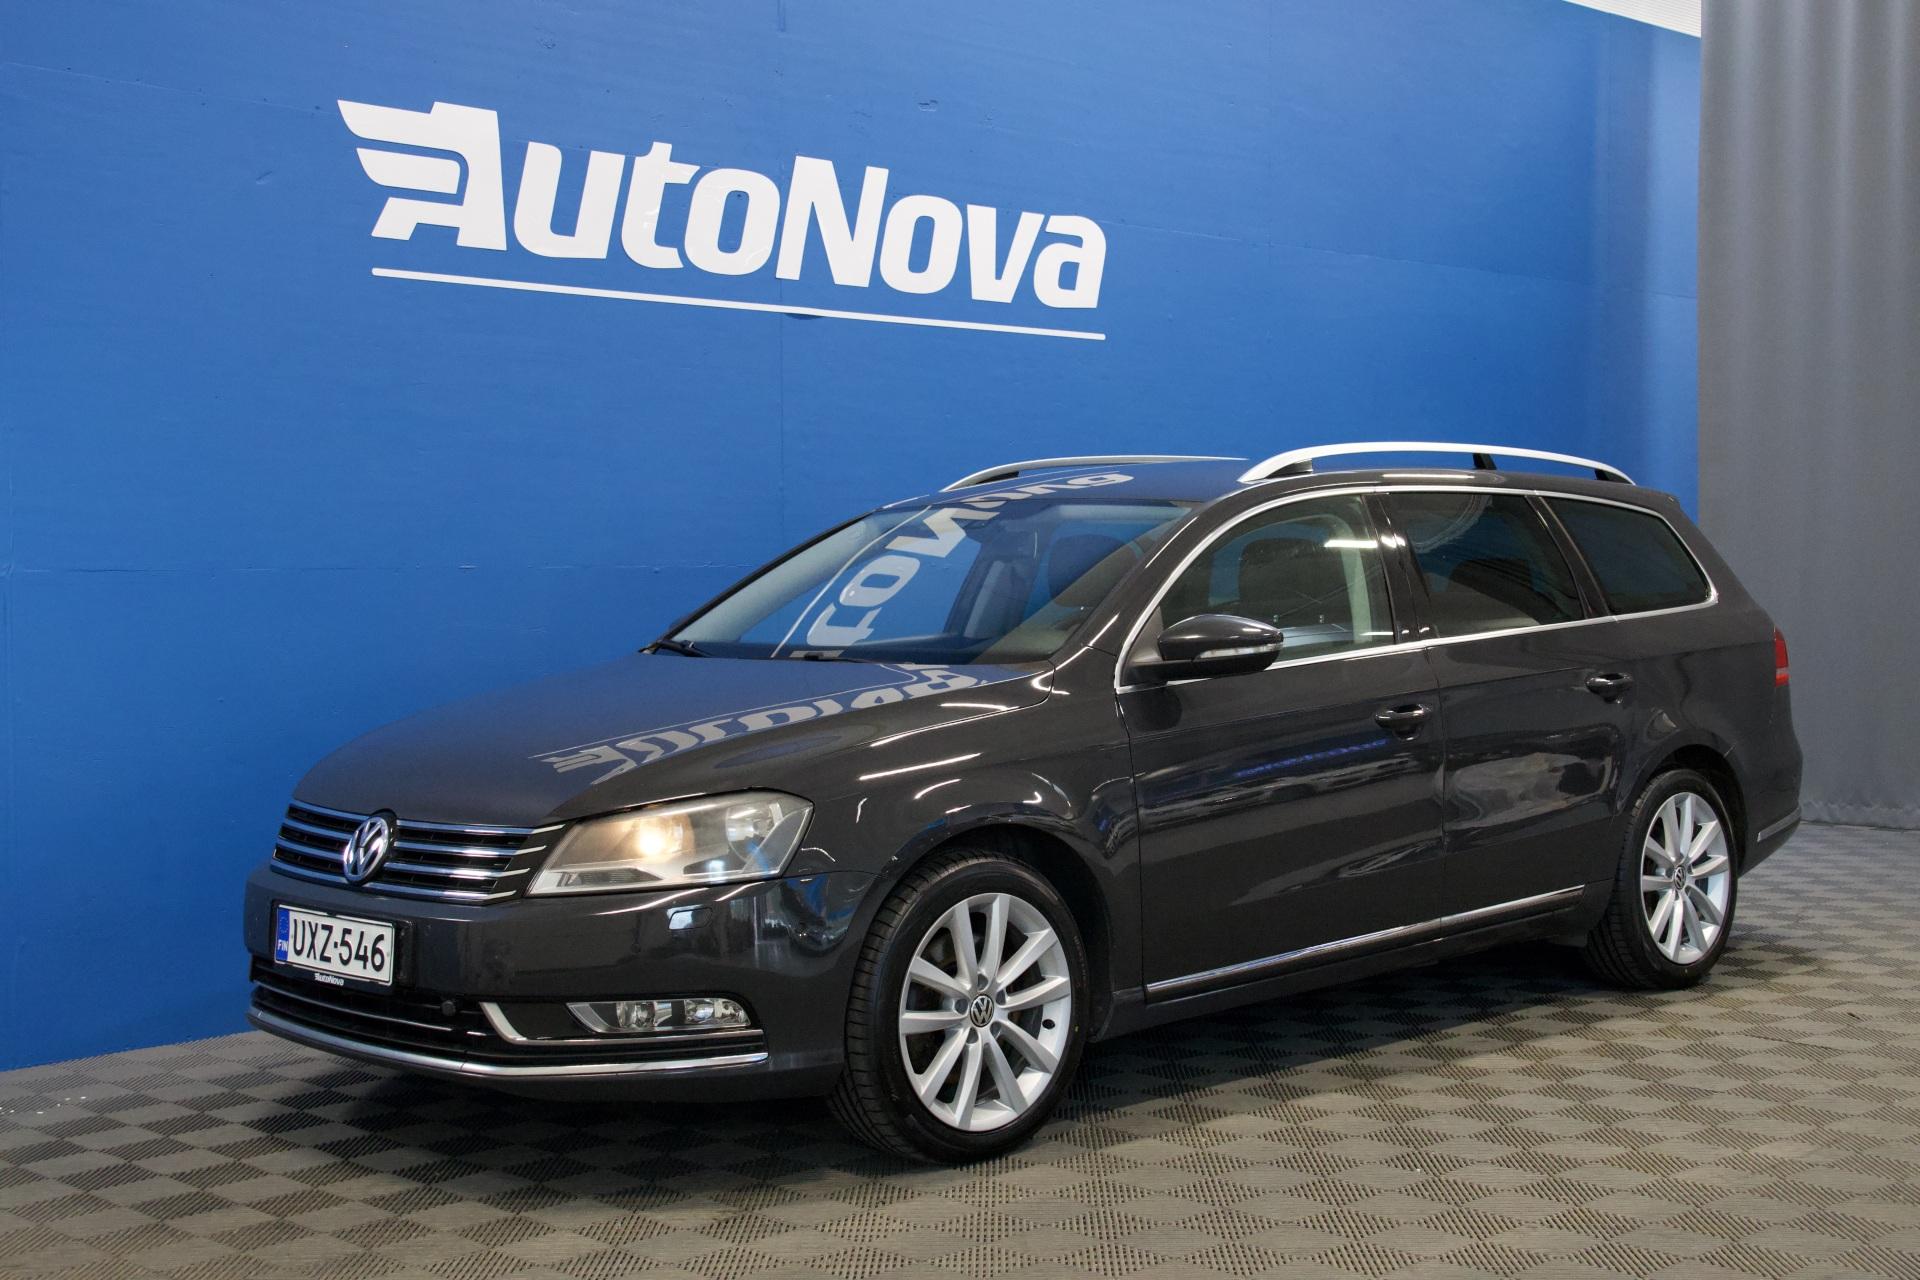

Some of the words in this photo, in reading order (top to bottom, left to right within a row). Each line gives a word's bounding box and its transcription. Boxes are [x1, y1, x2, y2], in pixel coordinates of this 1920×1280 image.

[337, 99, 1107, 309] AutoNova
[277, 939, 289, 952] FIN
[293, 918, 385, 972] UXZ-546
